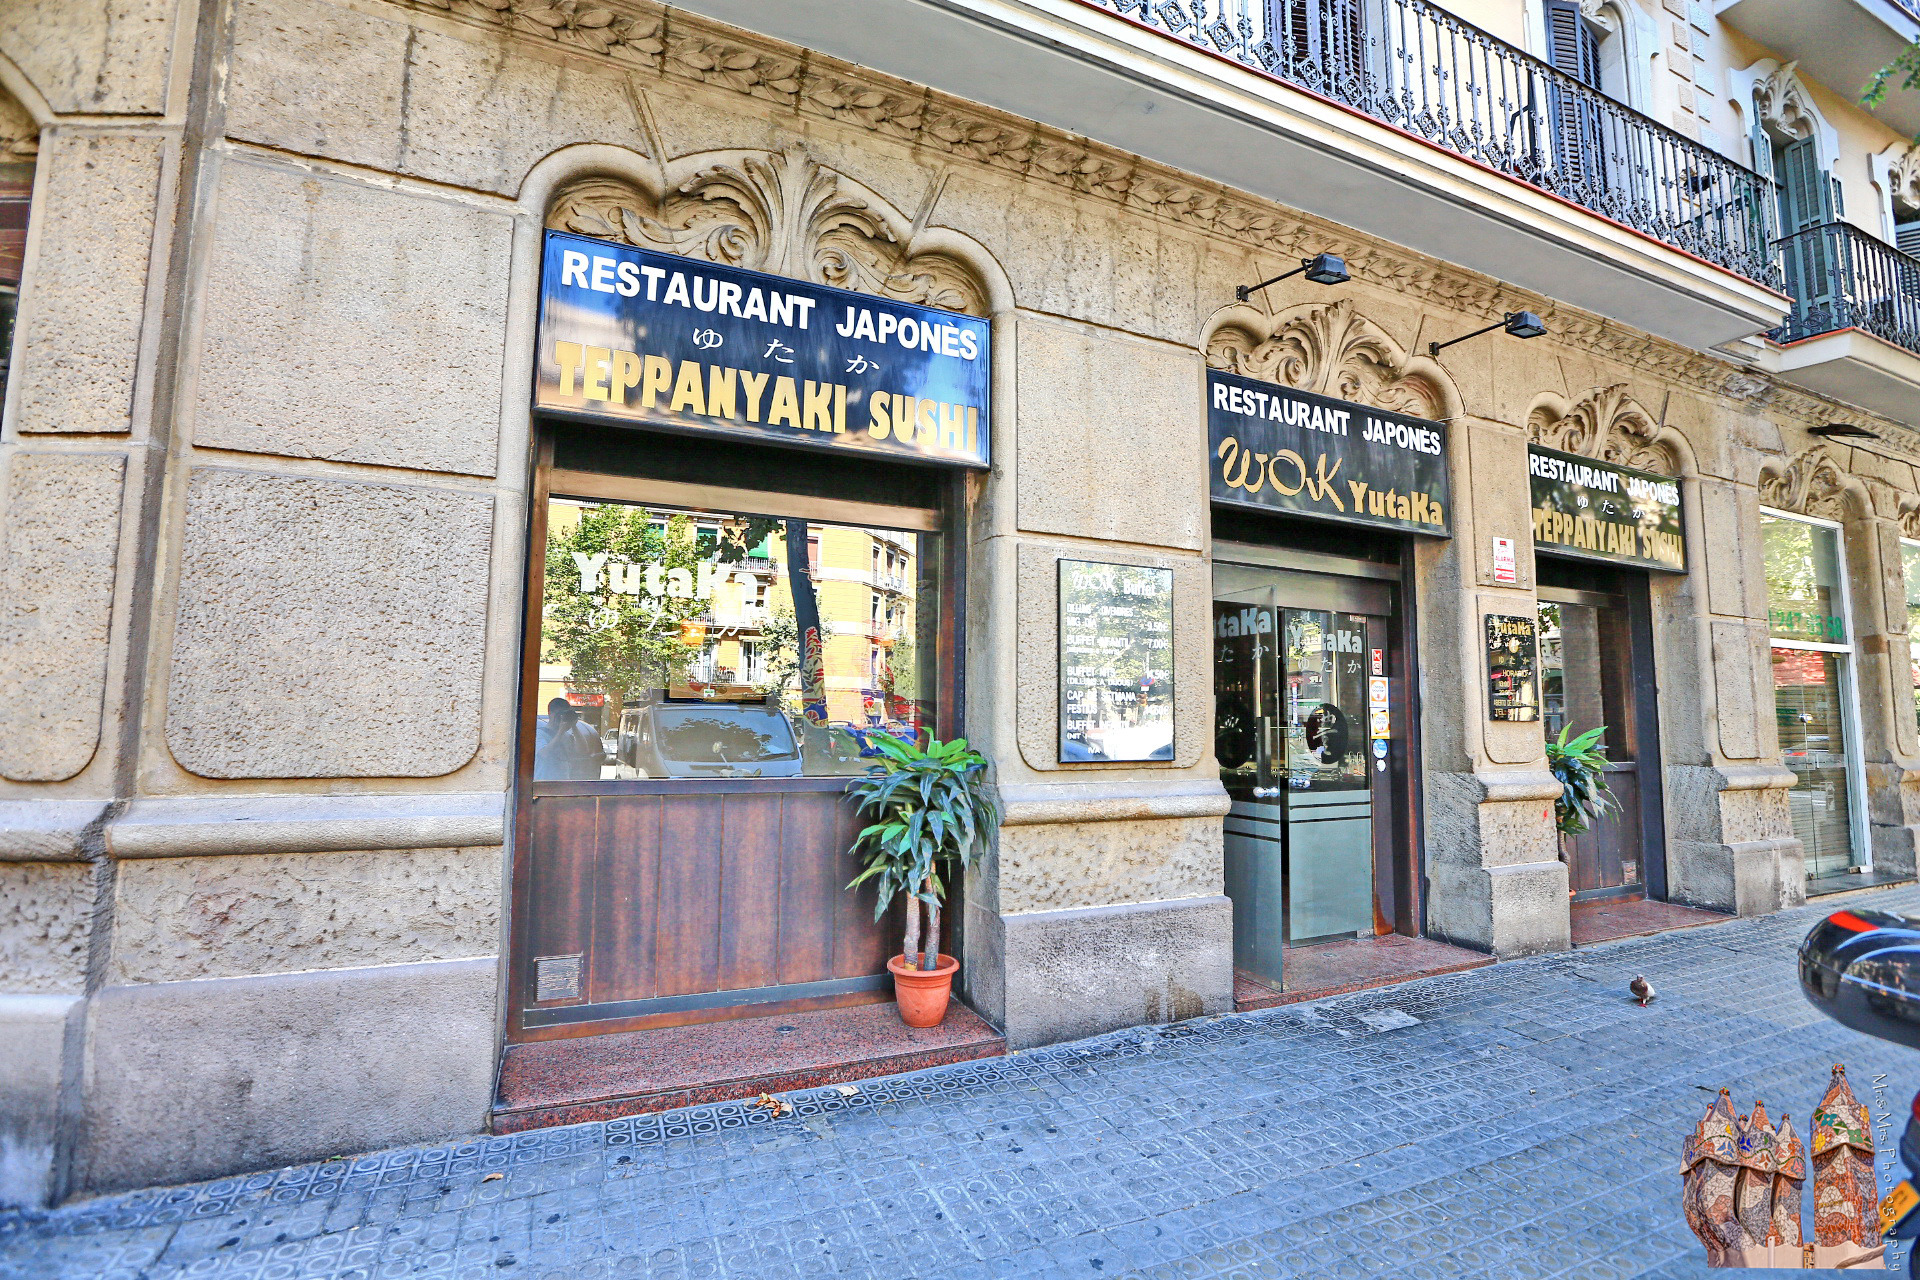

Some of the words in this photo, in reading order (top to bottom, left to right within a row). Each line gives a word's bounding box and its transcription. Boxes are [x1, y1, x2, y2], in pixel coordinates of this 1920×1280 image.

[561, 249, 815, 330] RESTAURANT
[835, 305, 978, 361] JAPONÈS
[555, 340, 847, 434] TEPPANYAKI
[868, 390, 978, 453] SUSHI
[1213, 383, 1350, 436] RESTAURANT
[1362, 417, 1441, 456] JAPONÈS
[1529, 453, 1619, 494] RESTAURANT
[1627, 477, 1680, 507] JAPONÈS
[1533, 508, 1636, 557] TEPPANYAKI
[1642, 528, 1684, 565] SUSHI
[1066, 635, 1095, 645] BUFFET
[1290, 624, 1363, 654] YtaKa
[1066, 666, 1095, 677] BUFFET
[1066, 690, 1084, 700] CAP
